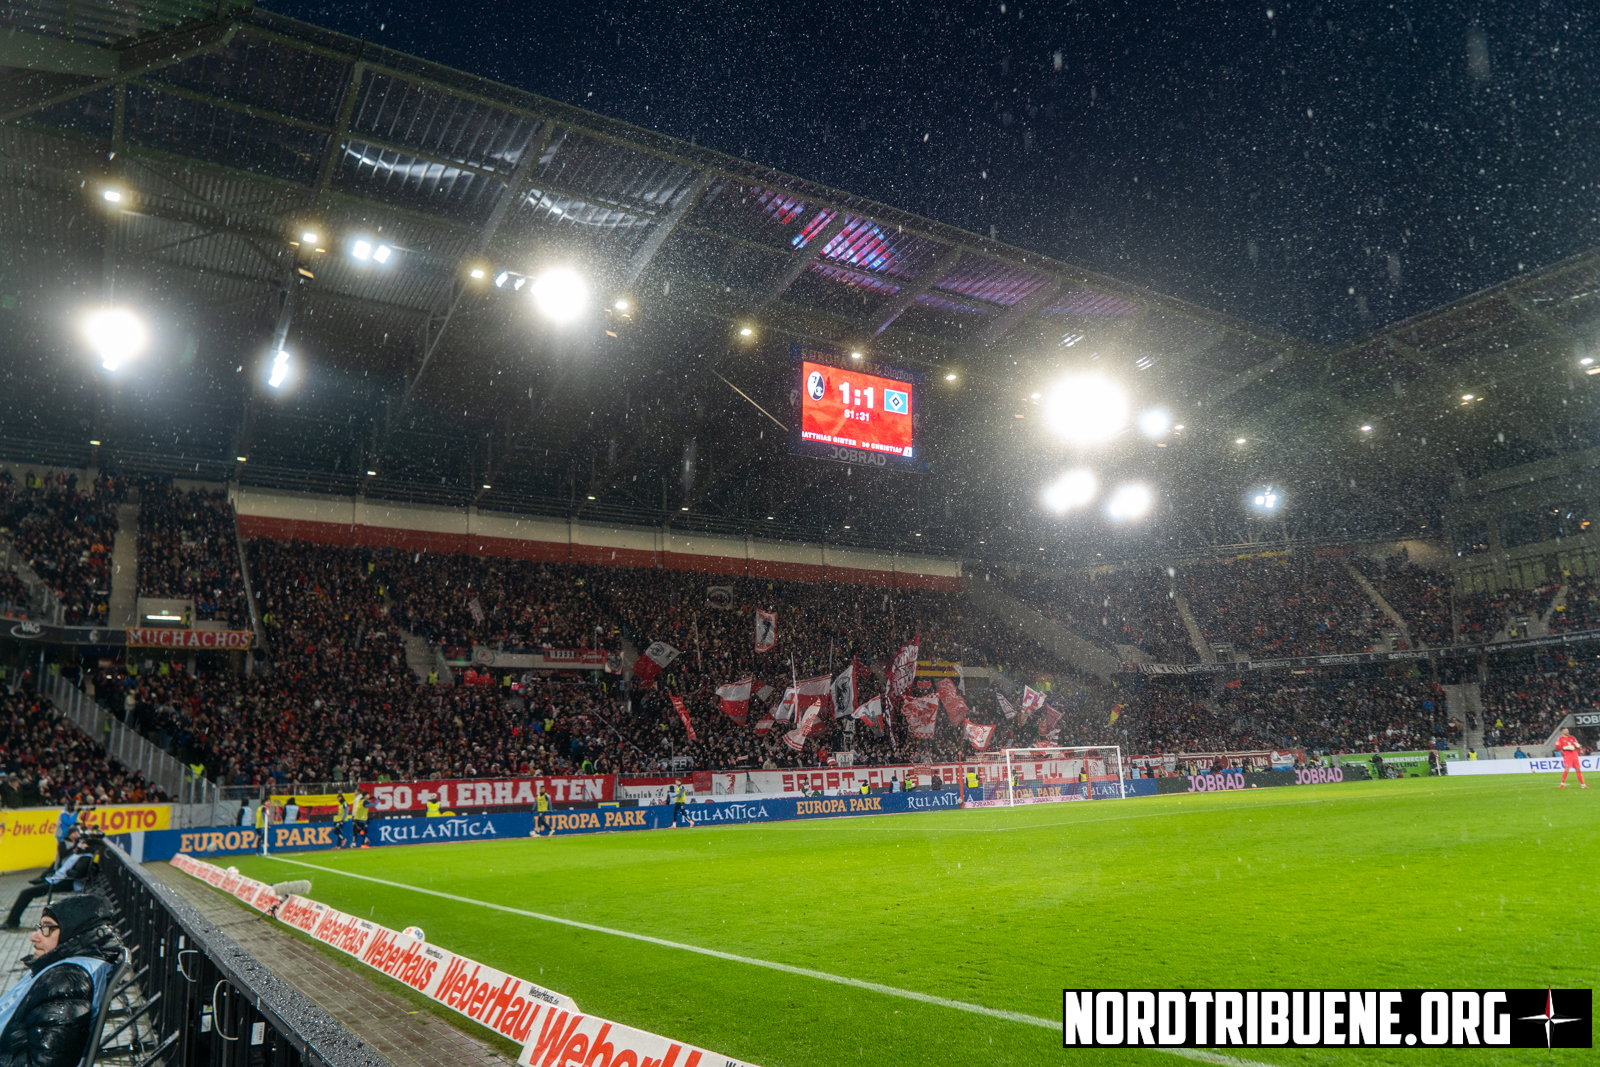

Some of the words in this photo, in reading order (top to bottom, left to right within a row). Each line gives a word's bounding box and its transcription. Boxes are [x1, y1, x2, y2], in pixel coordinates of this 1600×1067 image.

[838, 381, 874, 409] 1:1
[844, 409, 870, 422] 81:31
[833, 437, 857, 446] GINTER
[830, 446, 887, 466] JOBRAD
[20, 621, 41, 633] VAG
[129, 628, 250, 648] MUCHACHOS
[1576, 715, 1600, 725] JOB
[1187, 773, 1245, 793] JOBRAD
[1294, 767, 1343, 785] JOBRAD
[907, 792, 974, 810] RULANTIA
[1037, 786, 1062, 798] PARK
[796, 799, 847, 815] EUROPA
[850, 797, 882, 812] PARK
[101, 809, 157, 831] LOTTO
[604, 810, 647, 827] PARK
[275, 826, 333, 847] PARK
[313, 909, 369, 955] WeberHaus
[362, 928, 438, 991] WeberHaus
[433, 956, 541, 1043] WeberHau
